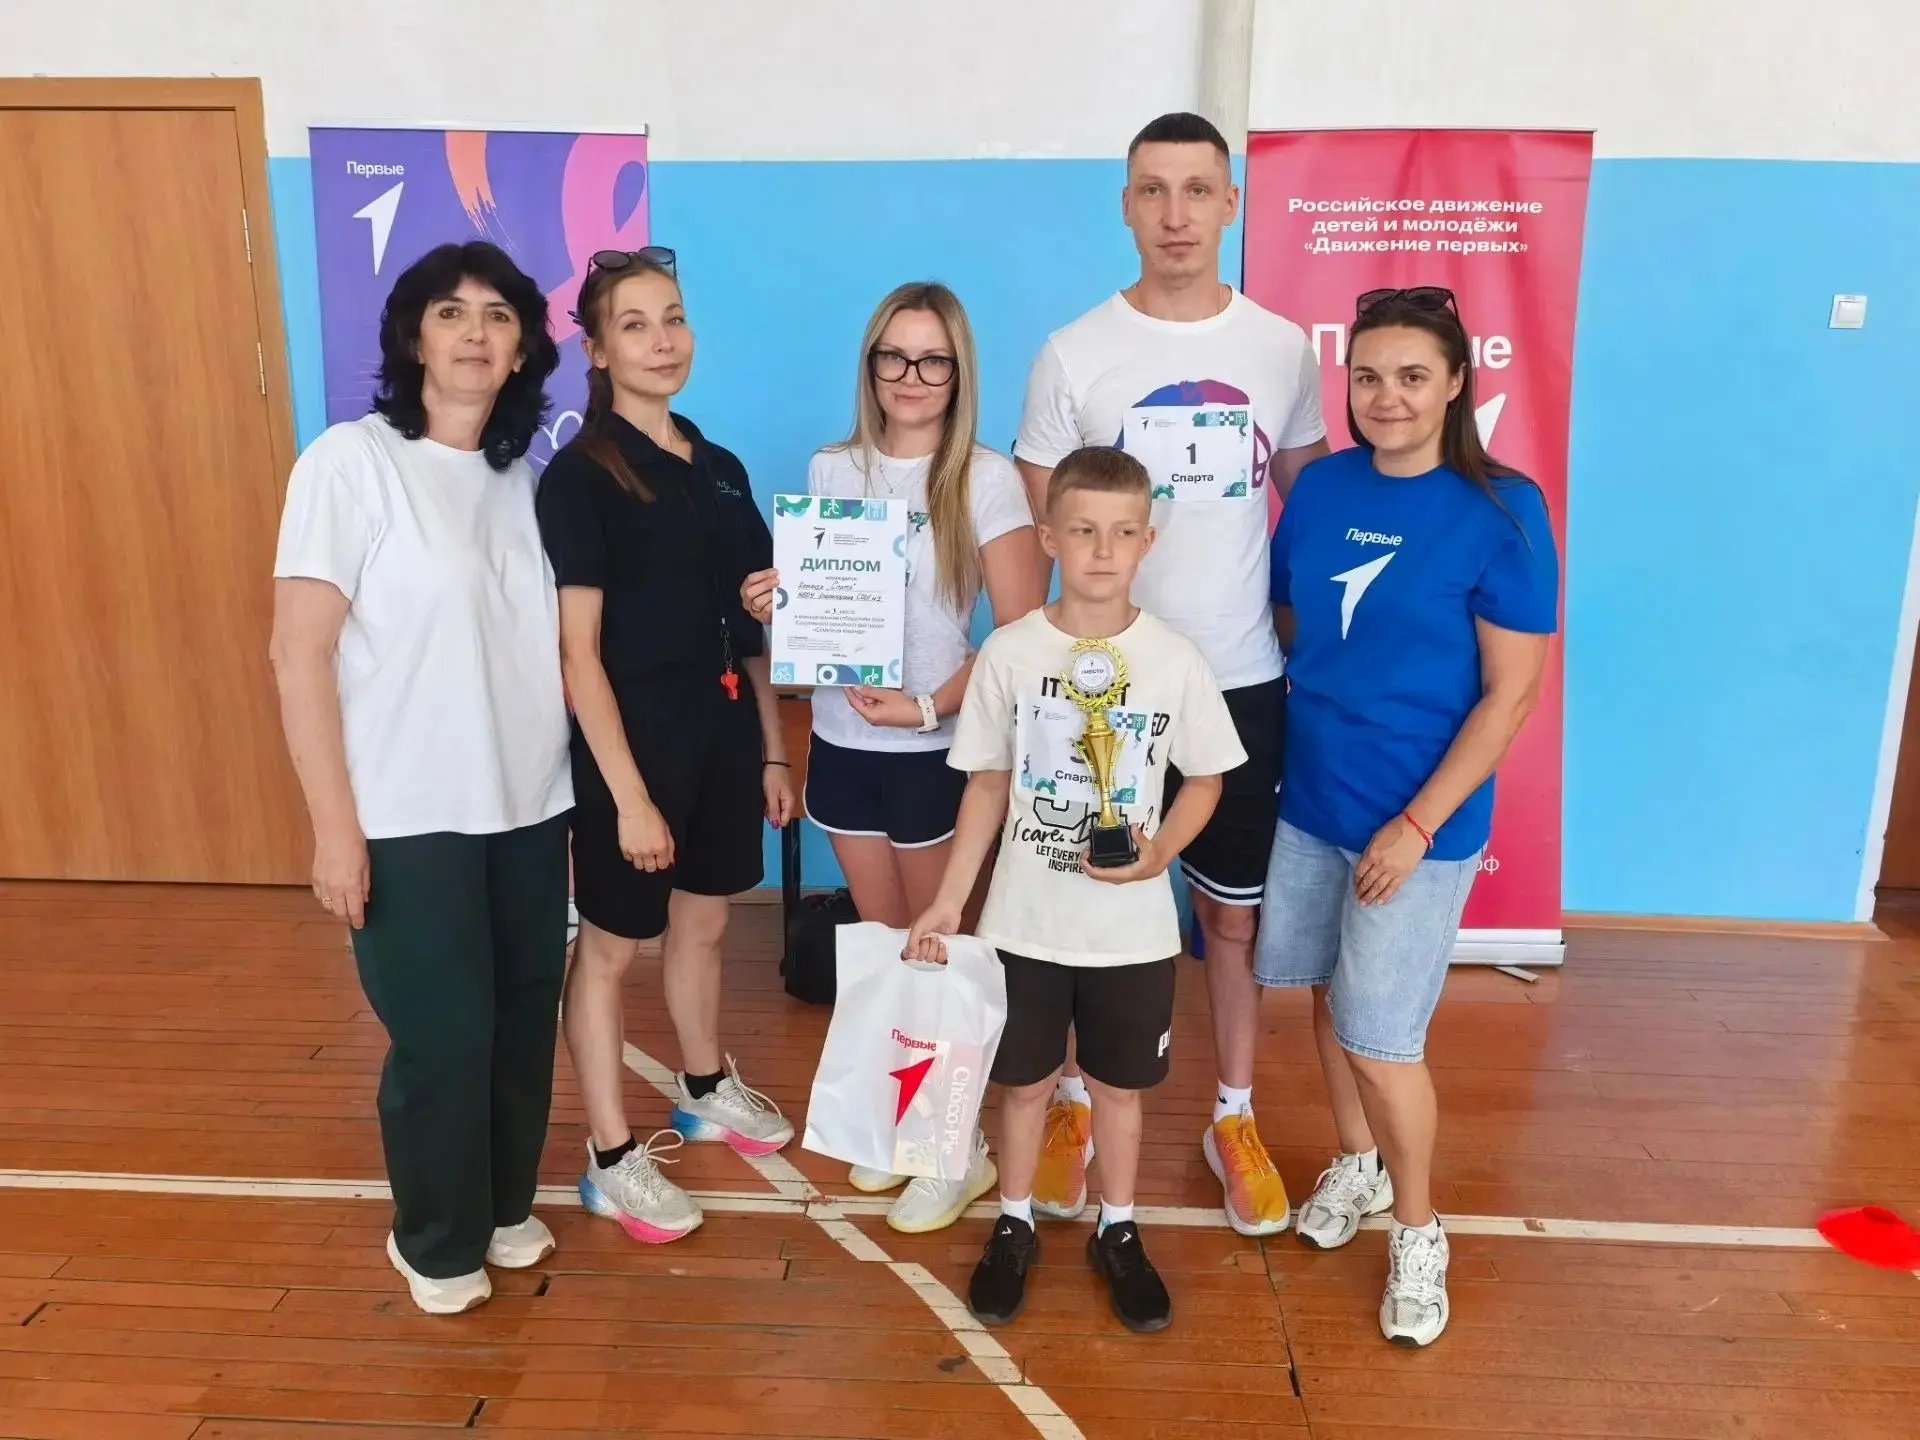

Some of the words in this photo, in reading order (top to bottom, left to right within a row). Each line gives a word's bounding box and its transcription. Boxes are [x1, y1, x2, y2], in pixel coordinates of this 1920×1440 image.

[346, 161, 404, 178] Первые
[1288, 197, 1425, 213] Российское
[1429, 199, 1543, 214] движение
[1312, 217, 1378, 235] детей
[1384, 220, 1397, 231] и
[1403, 216, 1518, 235] молодёжи
[1304, 237, 1431, 254] «Движение
[1436, 239, 1528, 256] первых»
[1186, 443, 1196, 465] 1
[1171, 473, 1214, 484] Спарта
[1346, 528, 1403, 546] Первые
[800, 558, 881, 572] ДИПЛОМ
[1036, 844, 1051, 857] LET
[891, 1029, 937, 1051] Первые
